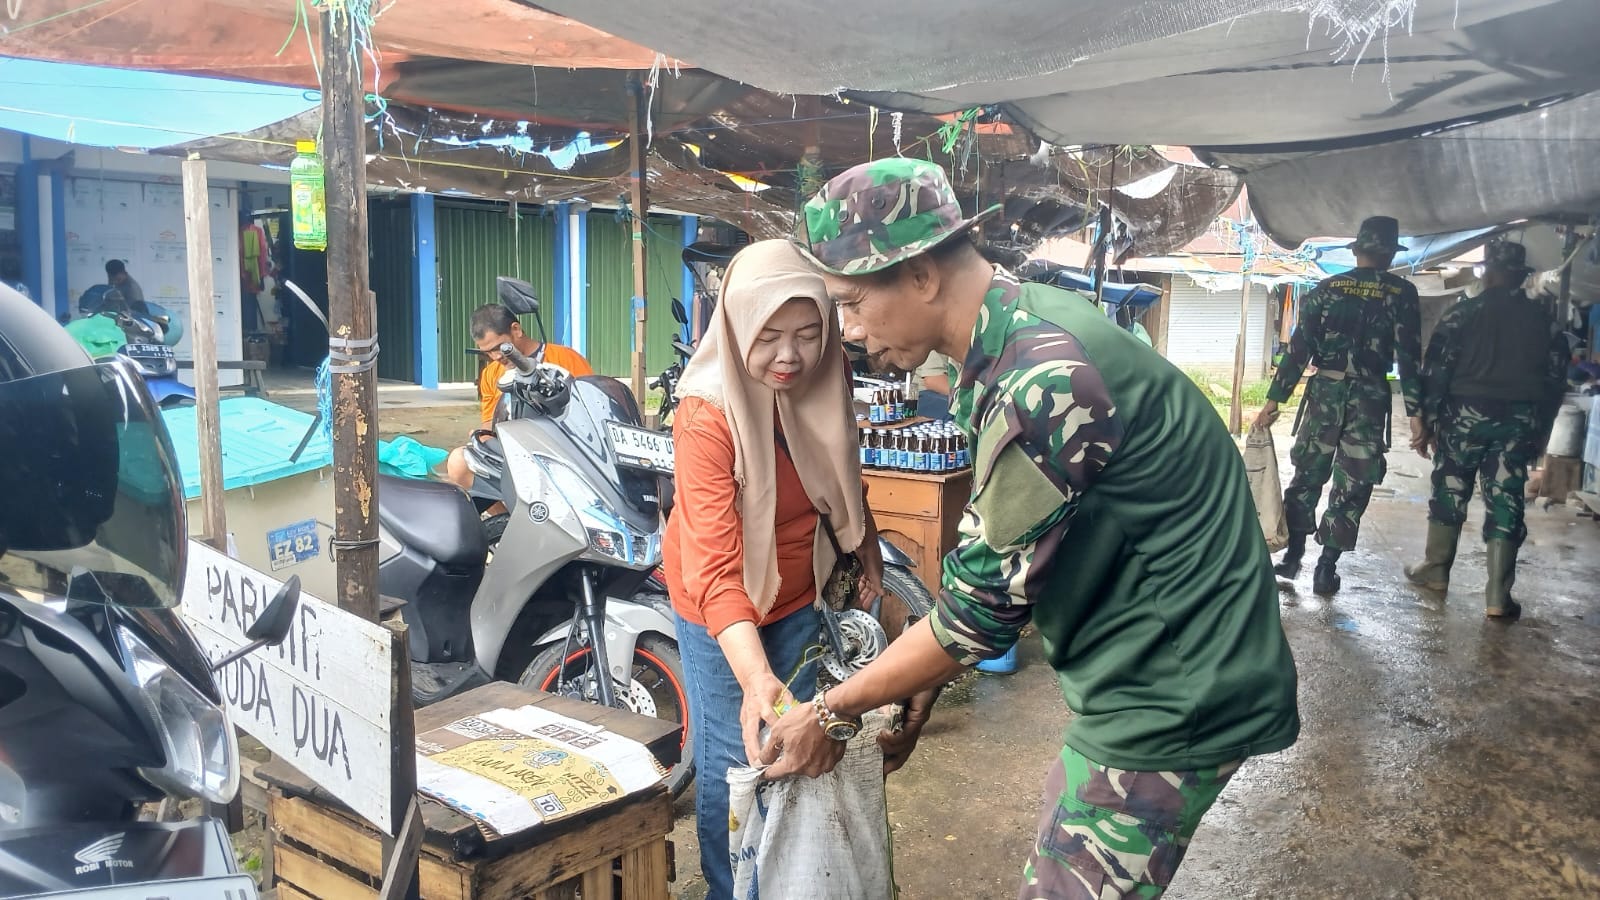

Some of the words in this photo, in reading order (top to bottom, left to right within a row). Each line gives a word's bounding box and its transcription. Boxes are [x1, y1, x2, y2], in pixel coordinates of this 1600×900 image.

[612, 427, 628, 445] DA
[632, 433, 660, 452] 5466
[664, 440, 674, 454] U
[295, 535, 314, 553] 82
[206, 564, 321, 680] PARIR
[209, 646, 277, 728] ODA
[293, 684, 352, 780] DUA
[506, 769, 550, 786] AREN
[75, 862, 100, 875] ROBI
[104, 859, 134, 868] MOTOR
